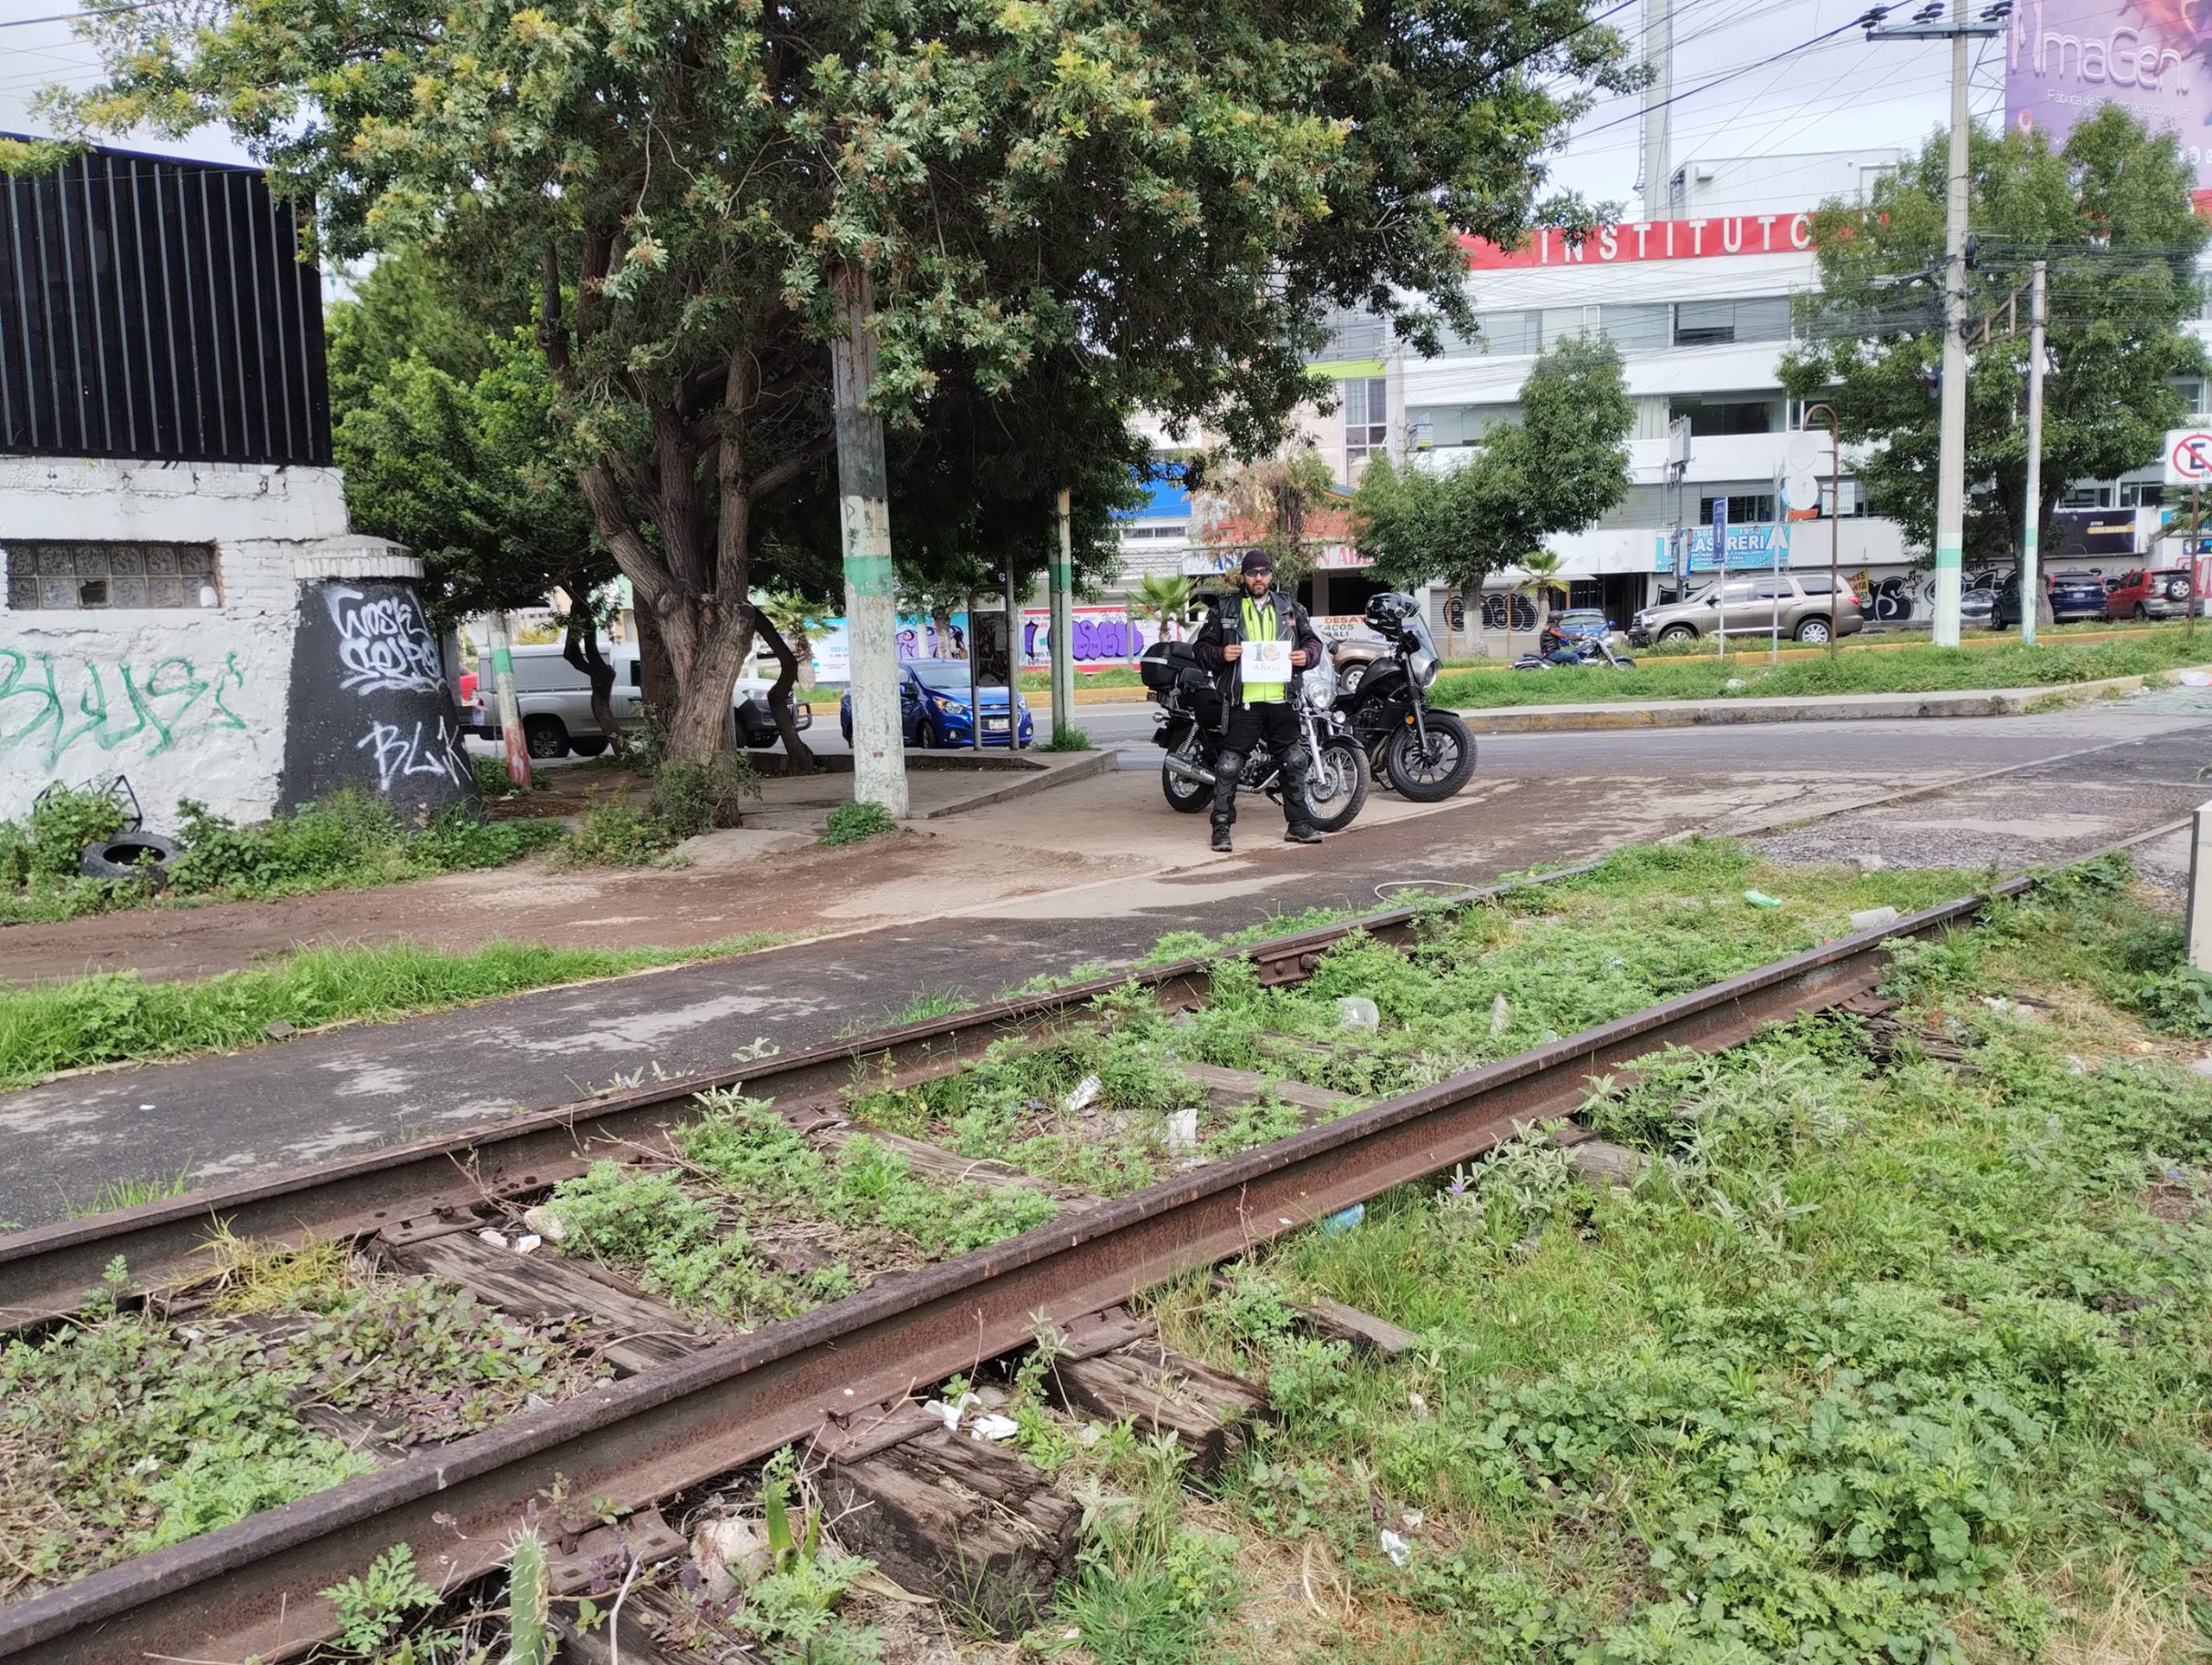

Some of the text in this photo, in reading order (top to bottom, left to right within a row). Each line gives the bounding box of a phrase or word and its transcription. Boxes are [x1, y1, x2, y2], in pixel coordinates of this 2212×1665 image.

[1541, 213, 1813, 264] INSTITUTO
[2190, 442, 2206, 470] E
[1318, 623, 1354, 632] TACOS
[1253, 661, 1281, 673] AÑOS
